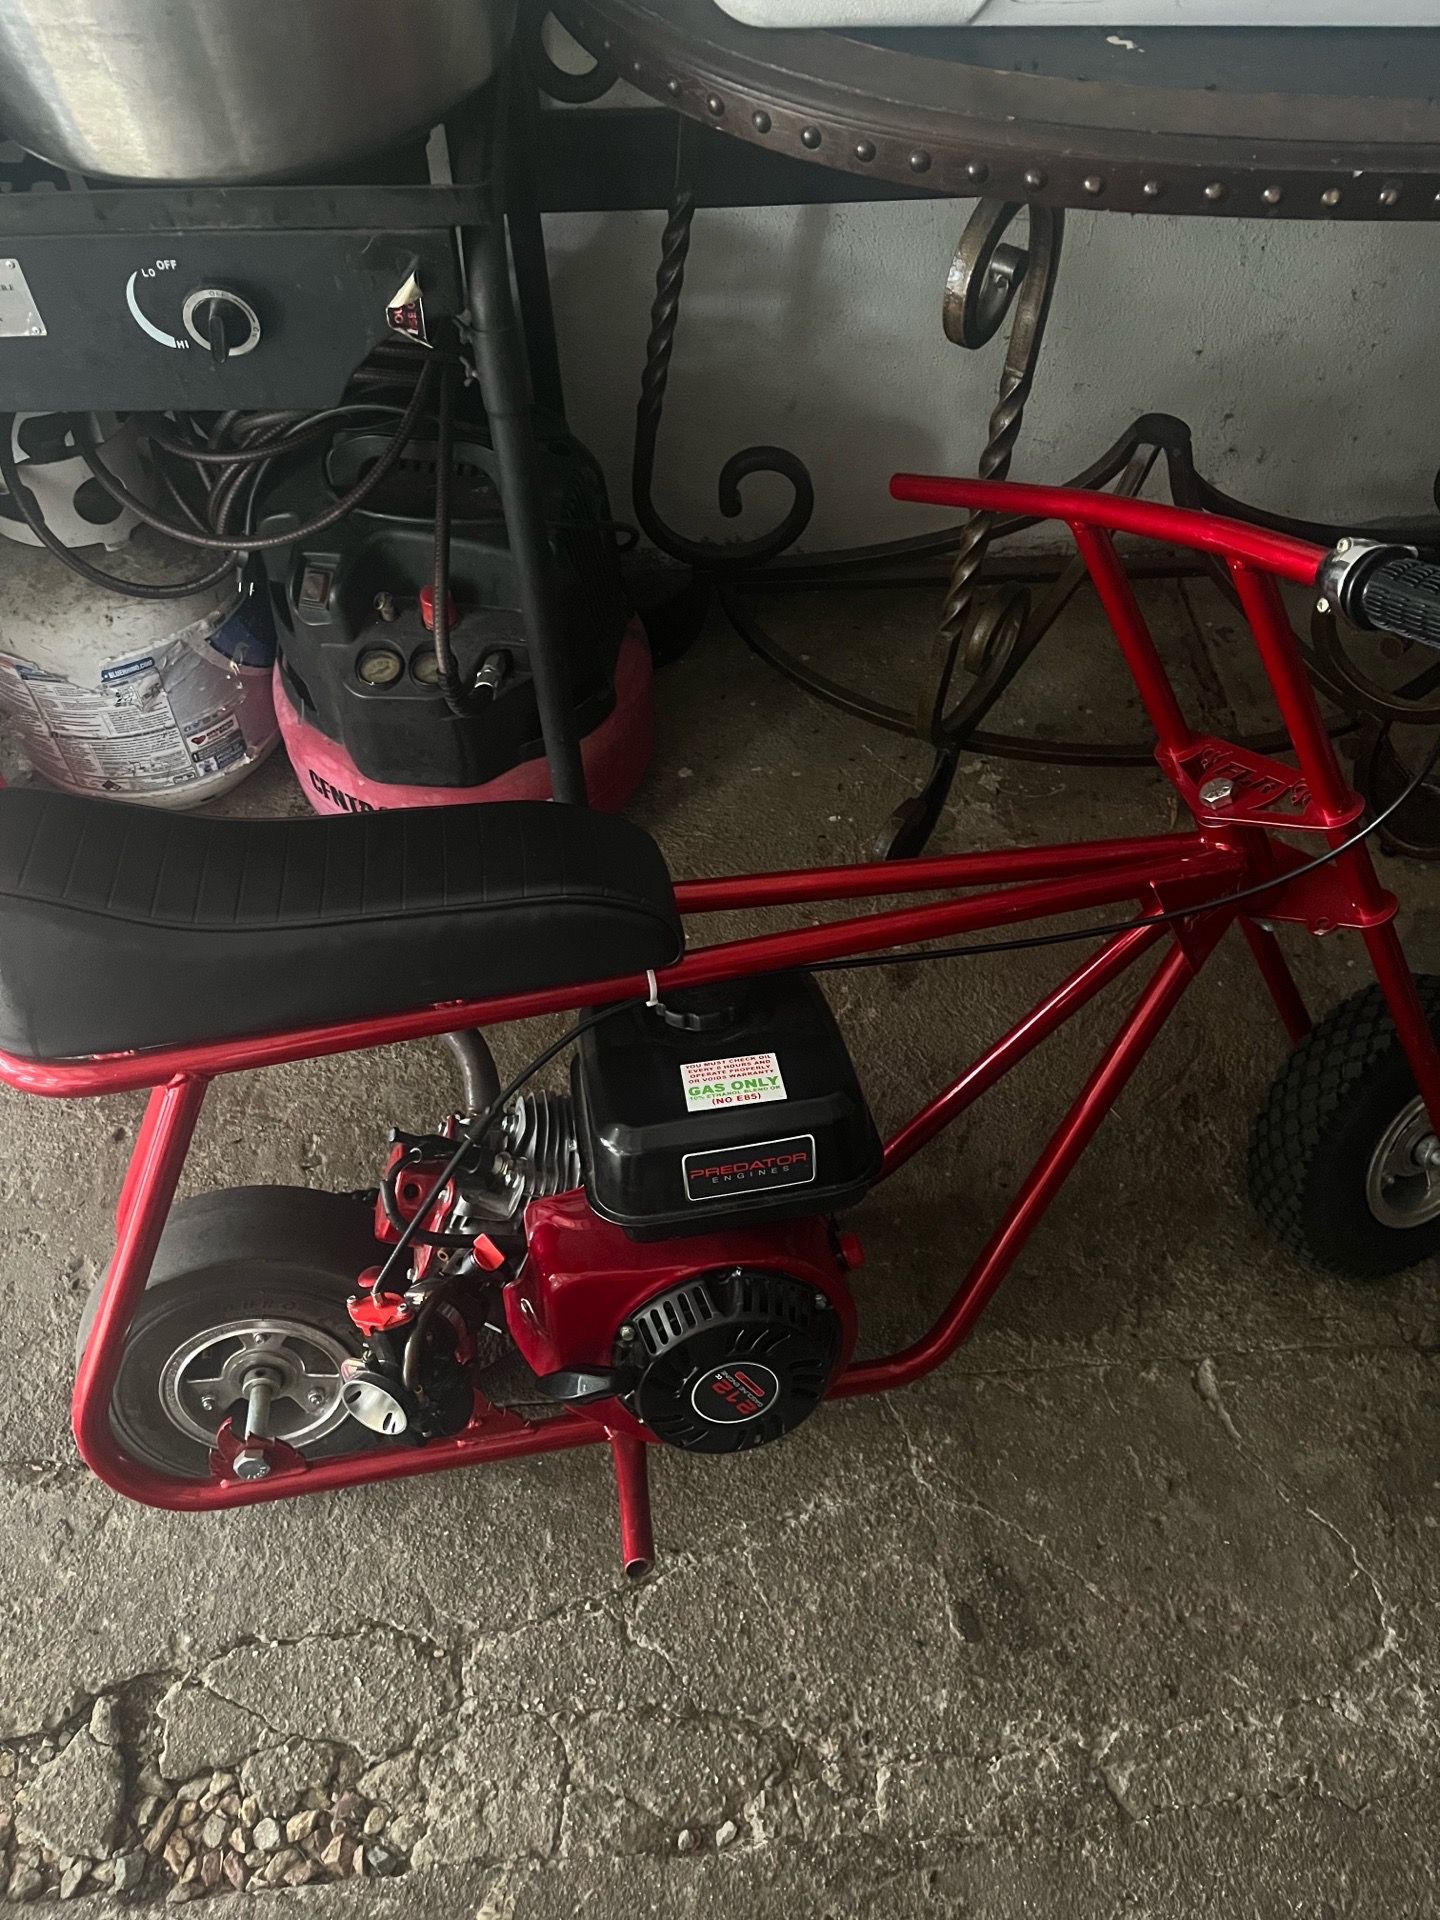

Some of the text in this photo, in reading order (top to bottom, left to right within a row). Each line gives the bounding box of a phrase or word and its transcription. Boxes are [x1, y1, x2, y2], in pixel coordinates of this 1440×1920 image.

[156, 260, 177, 270] OFF
[141, 268, 156, 277] LO
[176, 340, 190, 349] HI
[689, 1064, 771, 1079] OPERATE PROPERLY
[728, 1069, 775, 1078] WARRANTY
[688, 1075, 779, 1096] GAS ONLY
[706, 1090, 740, 1098] ETHANOL
[711, 1092, 761, 1106] (NO E85)
[689, 1152, 808, 1181] PREDATOR
[711, 1165, 790, 1184] ENGINES
